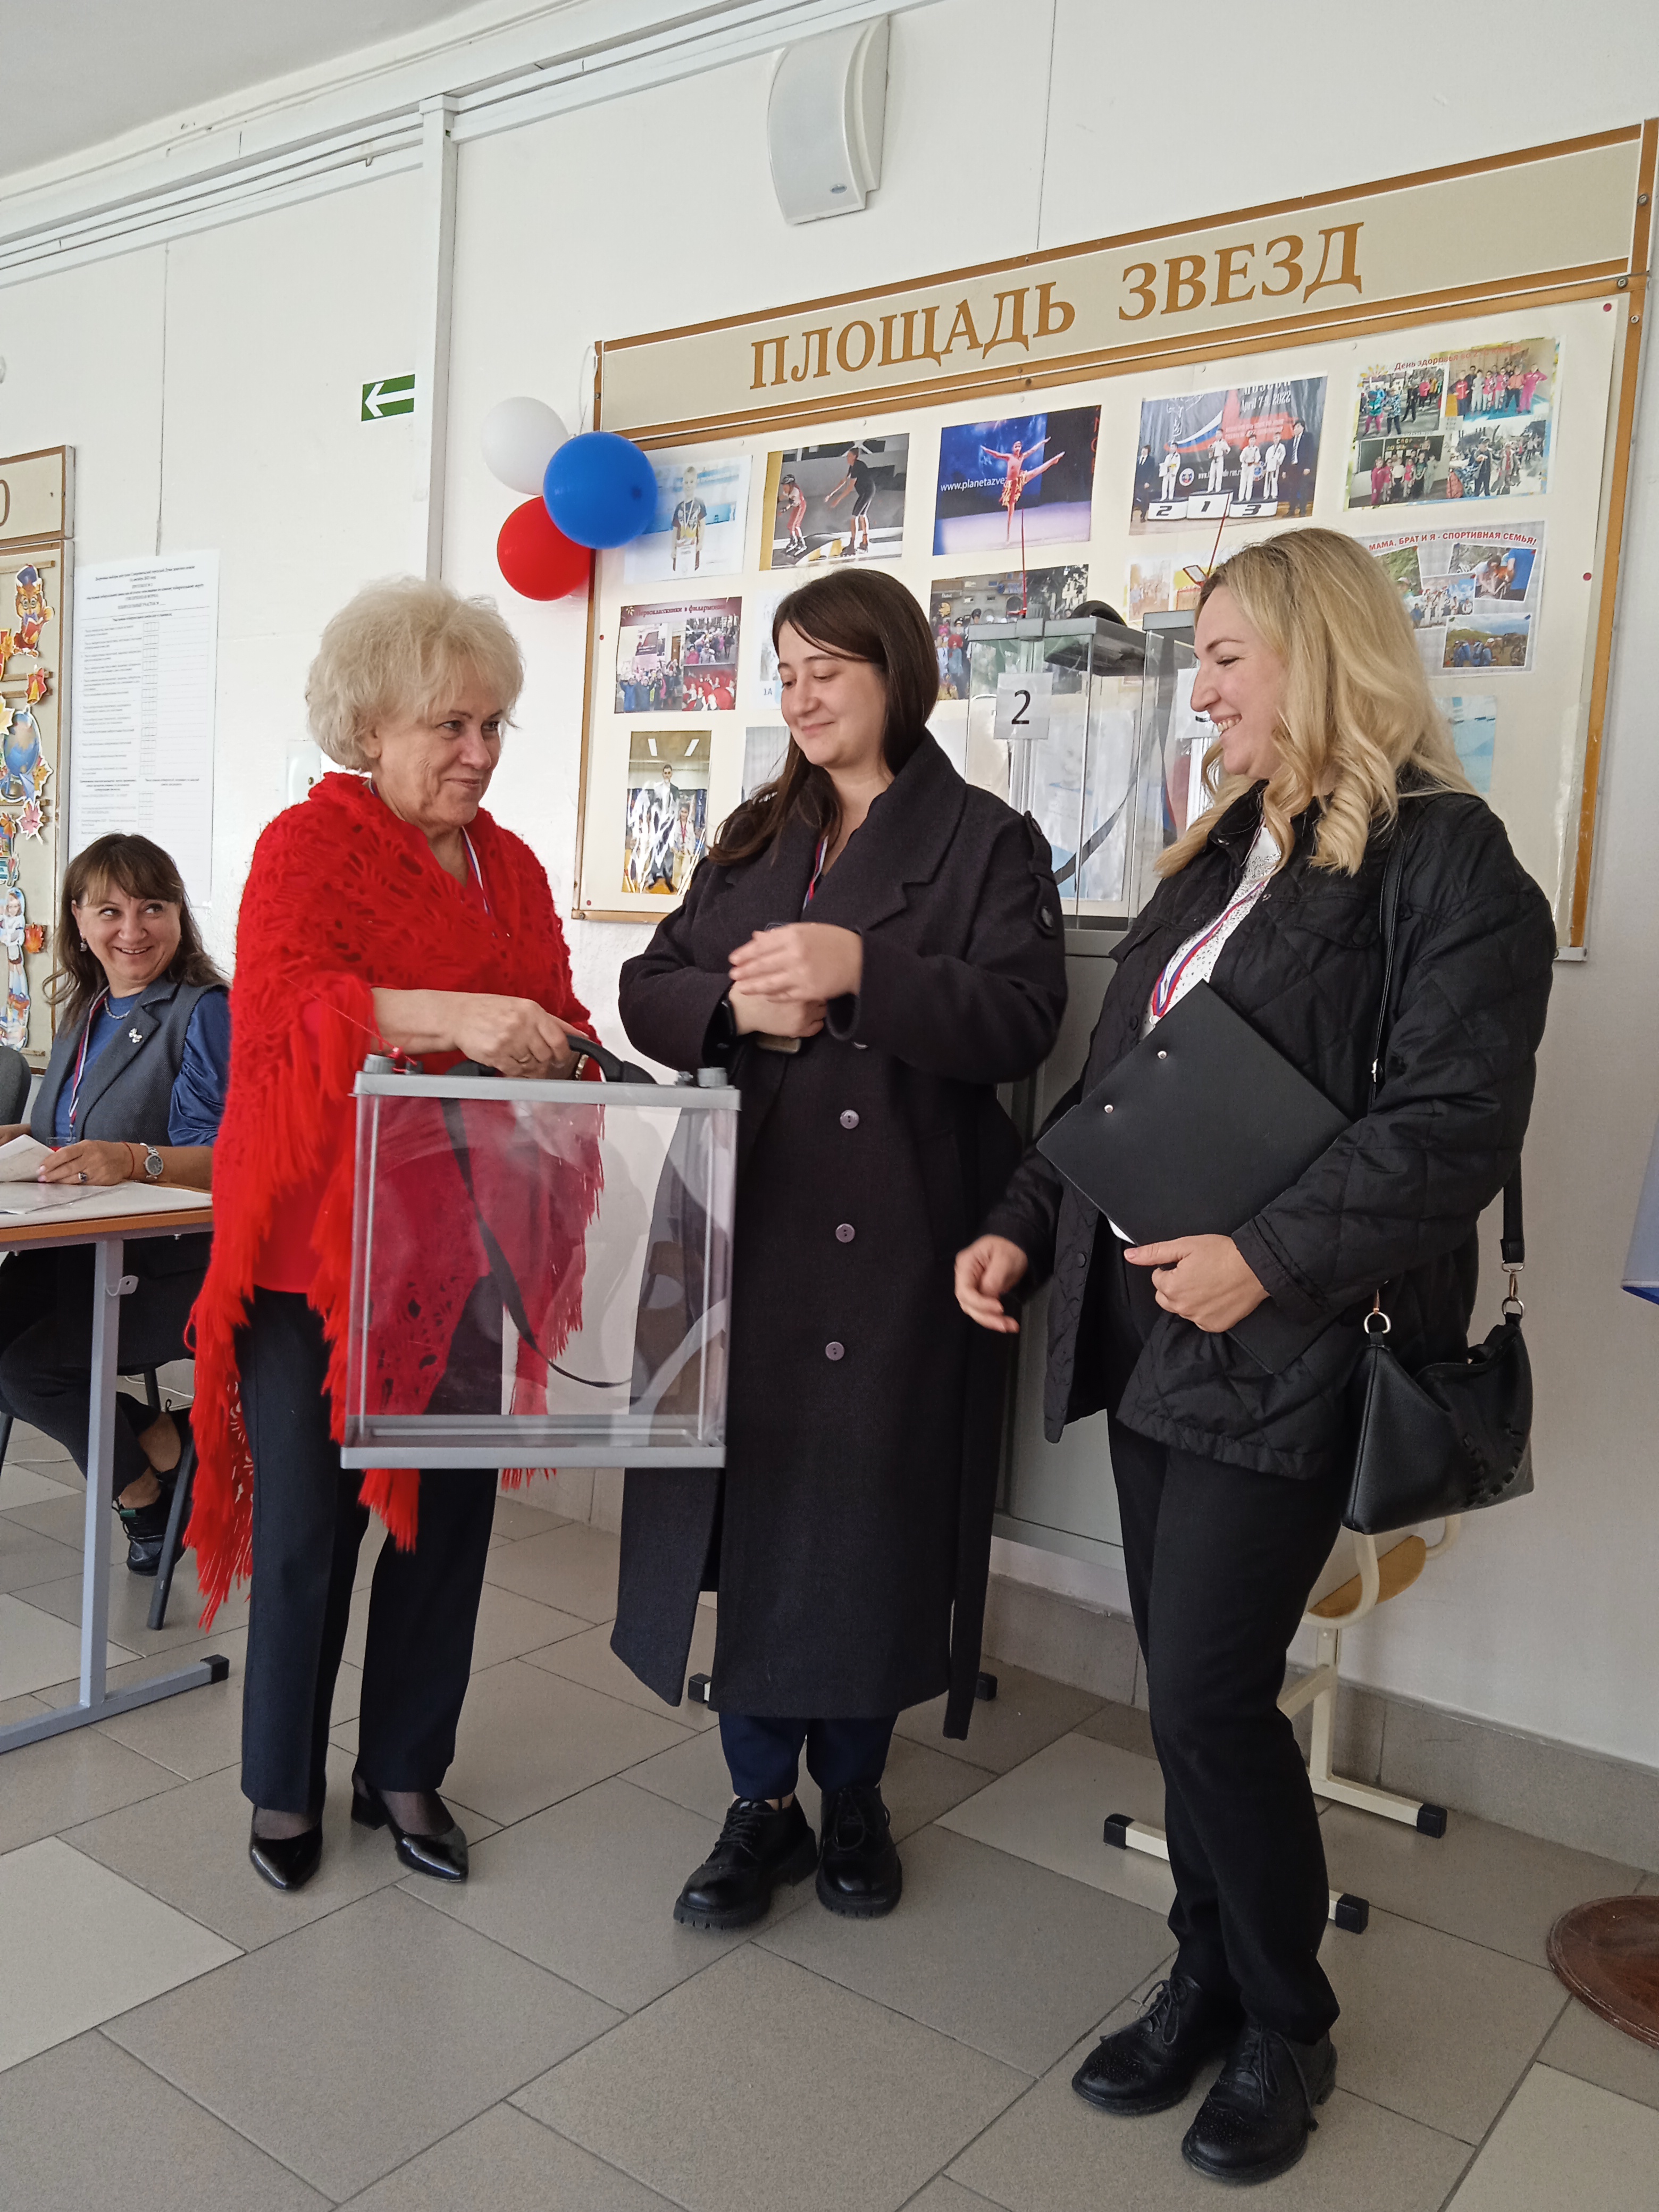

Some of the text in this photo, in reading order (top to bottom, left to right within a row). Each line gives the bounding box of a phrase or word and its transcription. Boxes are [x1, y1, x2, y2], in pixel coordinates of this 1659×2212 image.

[749, 222, 1364, 390] ПЛОЩАДЬ ЗВЕЗД
[1394, 363, 1415, 371] День
[1418, 355, 1458, 366] здоровья
[1242, 397, 1256, 413] April
[1272, 390, 1291, 405] 2022
[940, 477, 1008, 492] www.planetazve
[1156, 506, 1172, 516] 2
[1201, 501, 1211, 512] 1
[1242, 505, 1262, 516] 3
[1369, 540, 1397, 551] МАМА,
[1398, 535, 1419, 545] БРАТ
[1443, 531, 1501, 540] СПОРТИВНАЯ
[1503, 533, 1537, 546] СЕМЬЯ!
[1011, 690, 1032, 725] 2
